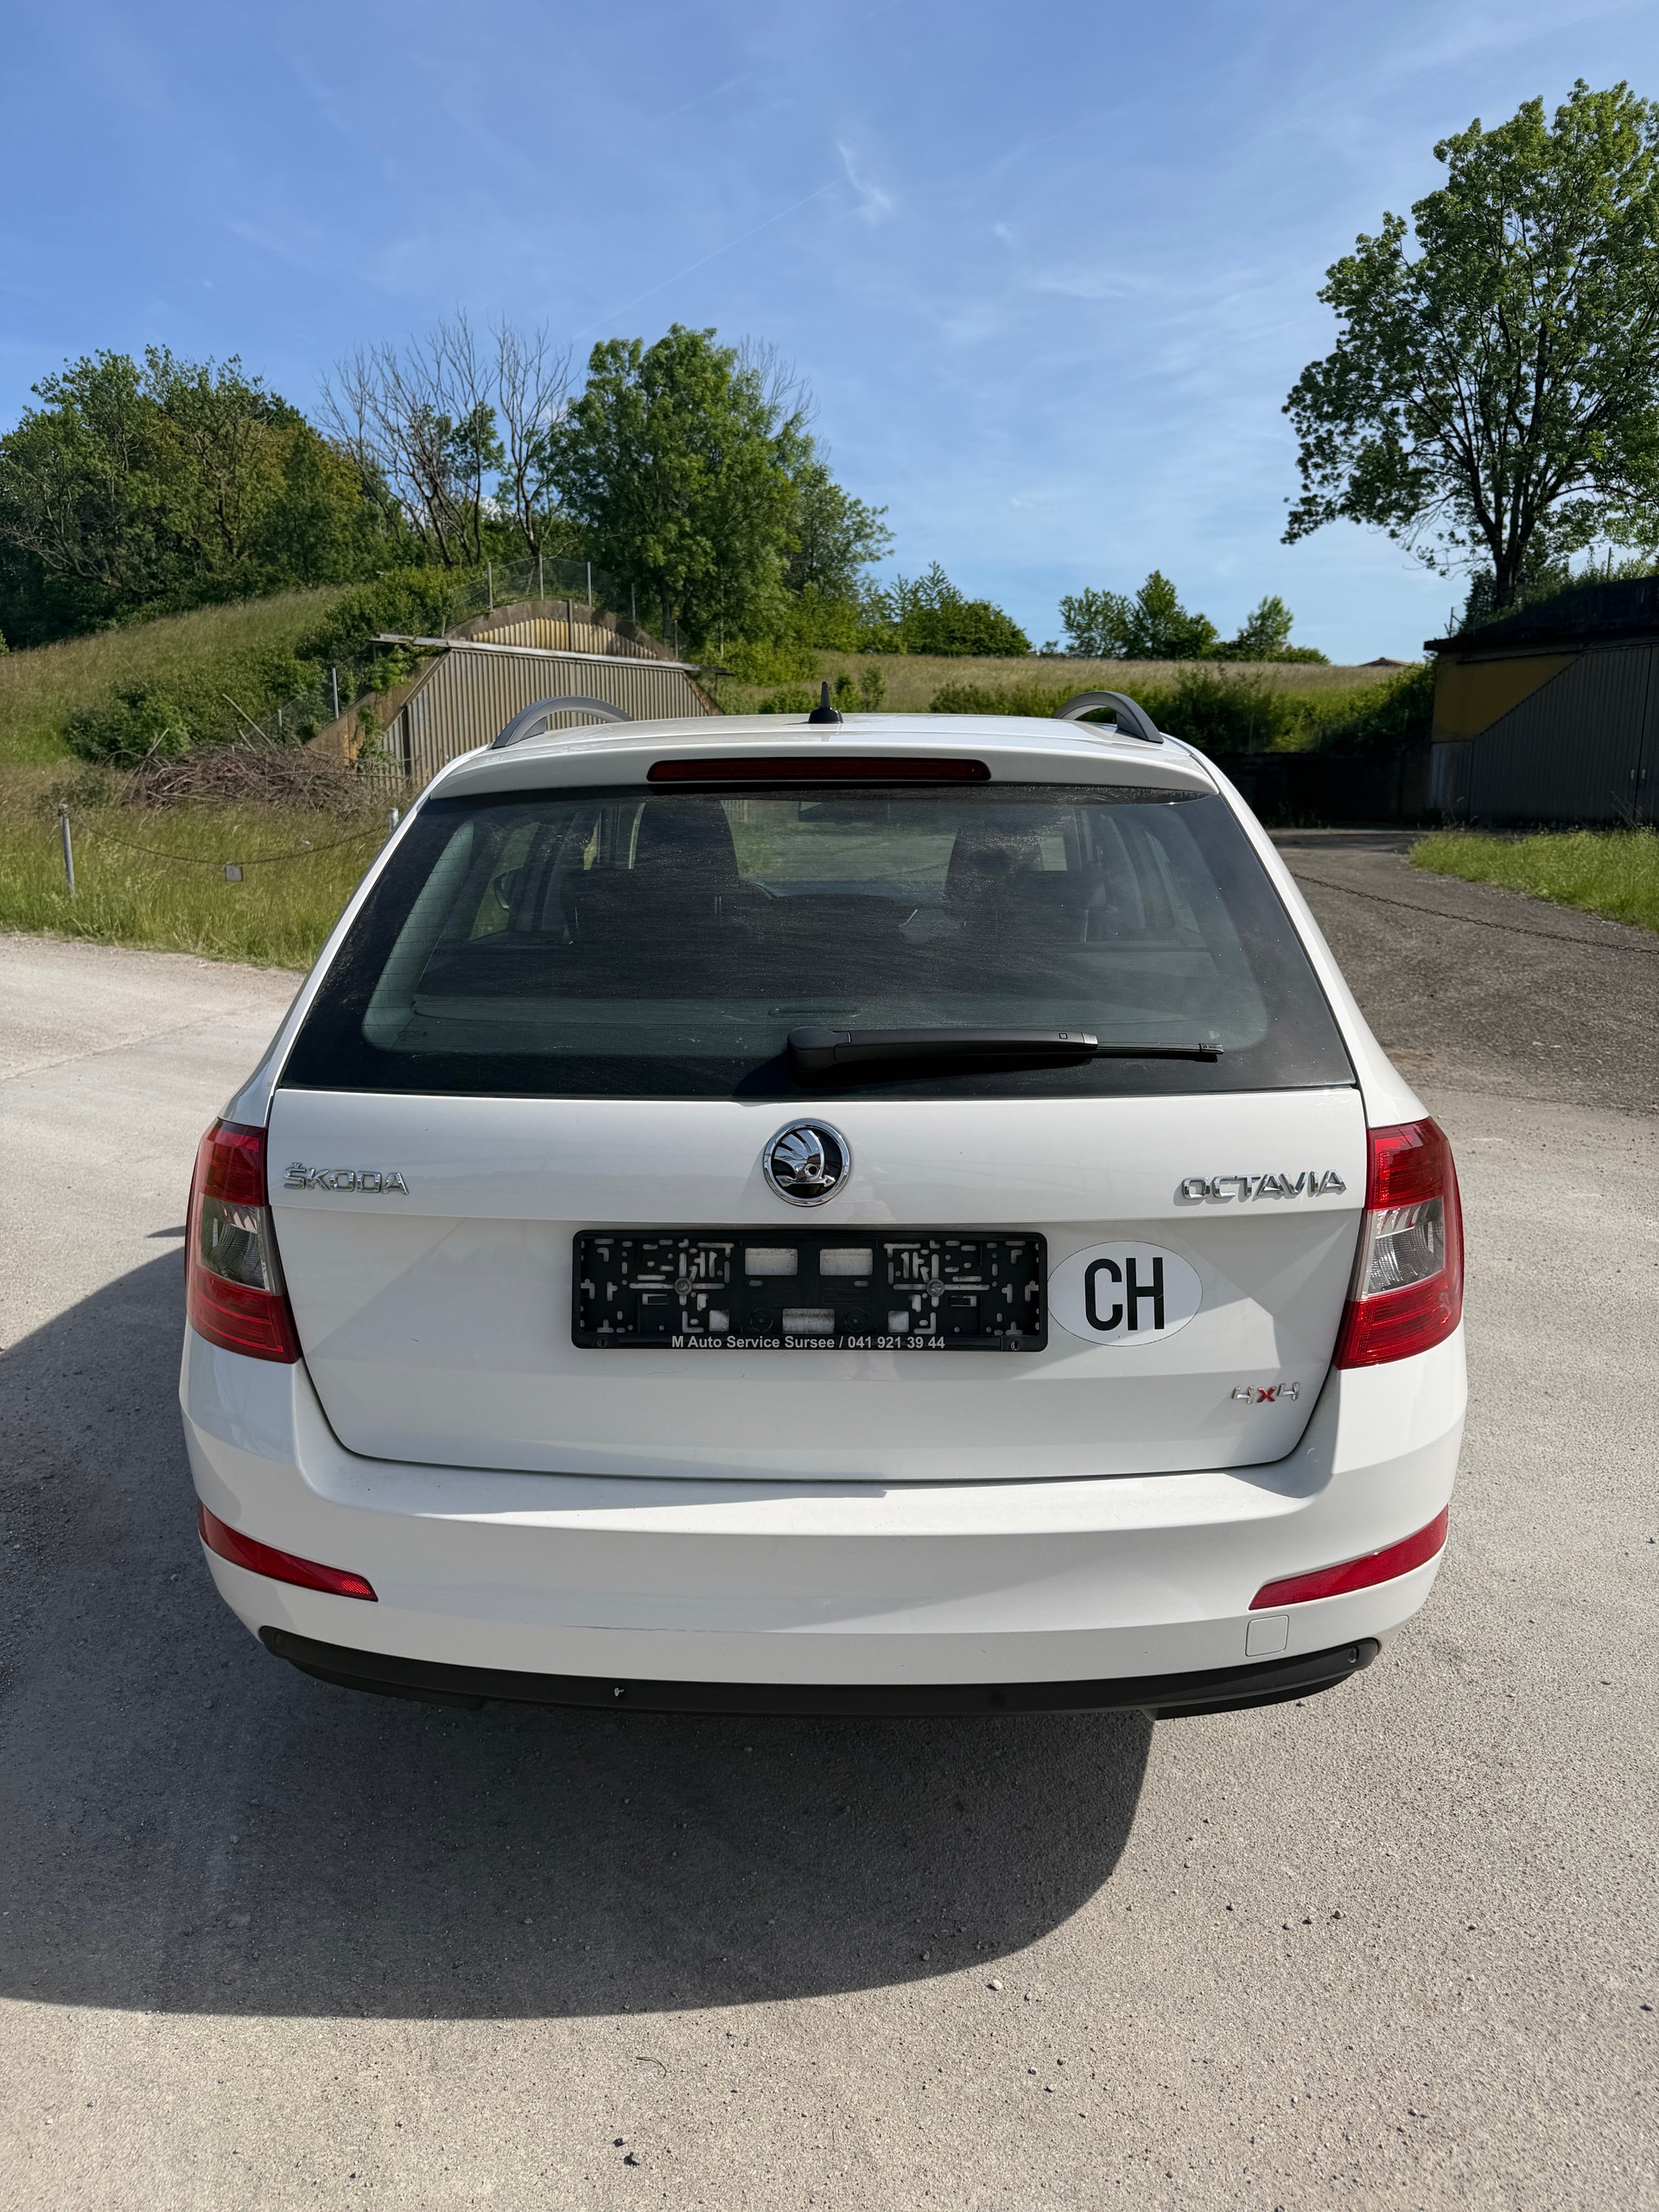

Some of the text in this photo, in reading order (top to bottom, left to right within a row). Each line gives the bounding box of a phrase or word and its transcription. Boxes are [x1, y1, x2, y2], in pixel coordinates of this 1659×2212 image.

[283, 1162, 410, 1195] ŠKODA
[1182, 1169, 1347, 1199] OCTAVIA
[1084, 1256, 1165, 1331] CH
[671, 1335, 945, 1349] M Auto Service Sursee / 041 921 39 44
